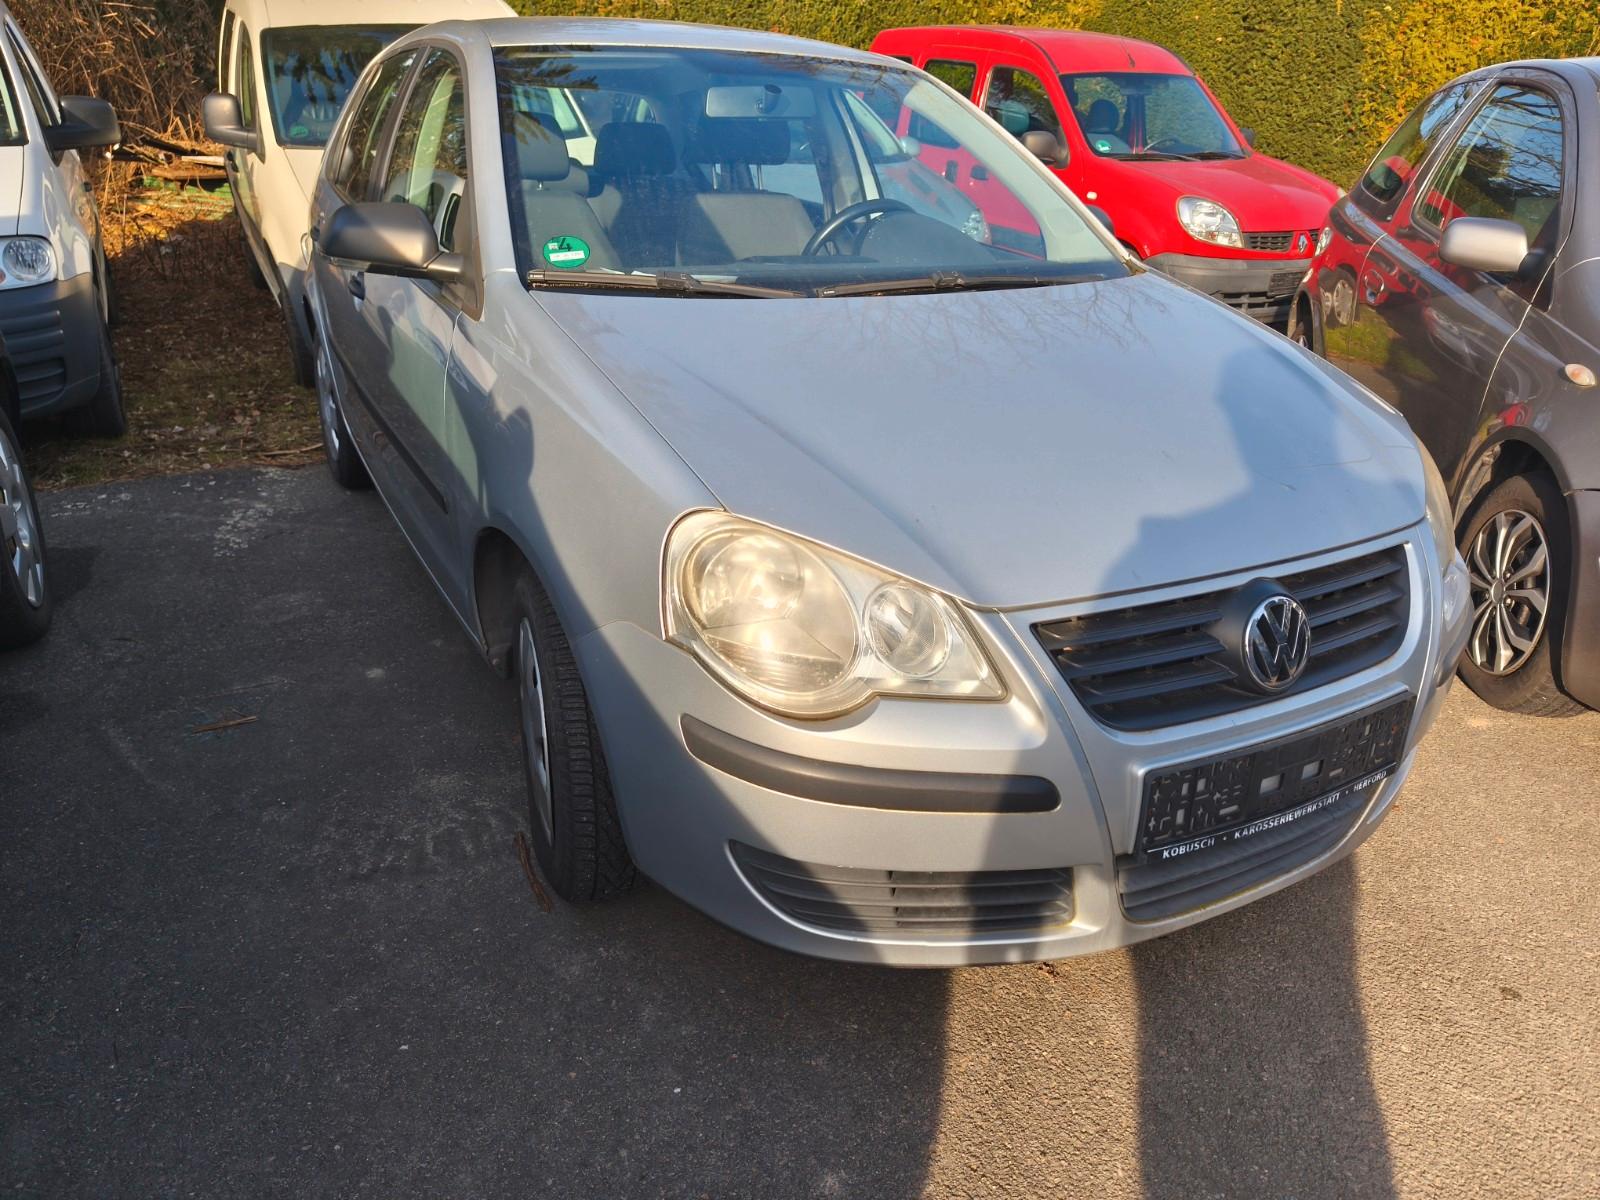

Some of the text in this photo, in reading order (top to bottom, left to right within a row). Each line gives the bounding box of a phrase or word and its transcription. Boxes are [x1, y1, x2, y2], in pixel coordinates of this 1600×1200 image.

[1162, 770, 1387, 859] KOBUSCH KAROSSERIEWERKSTATT HERFORD
